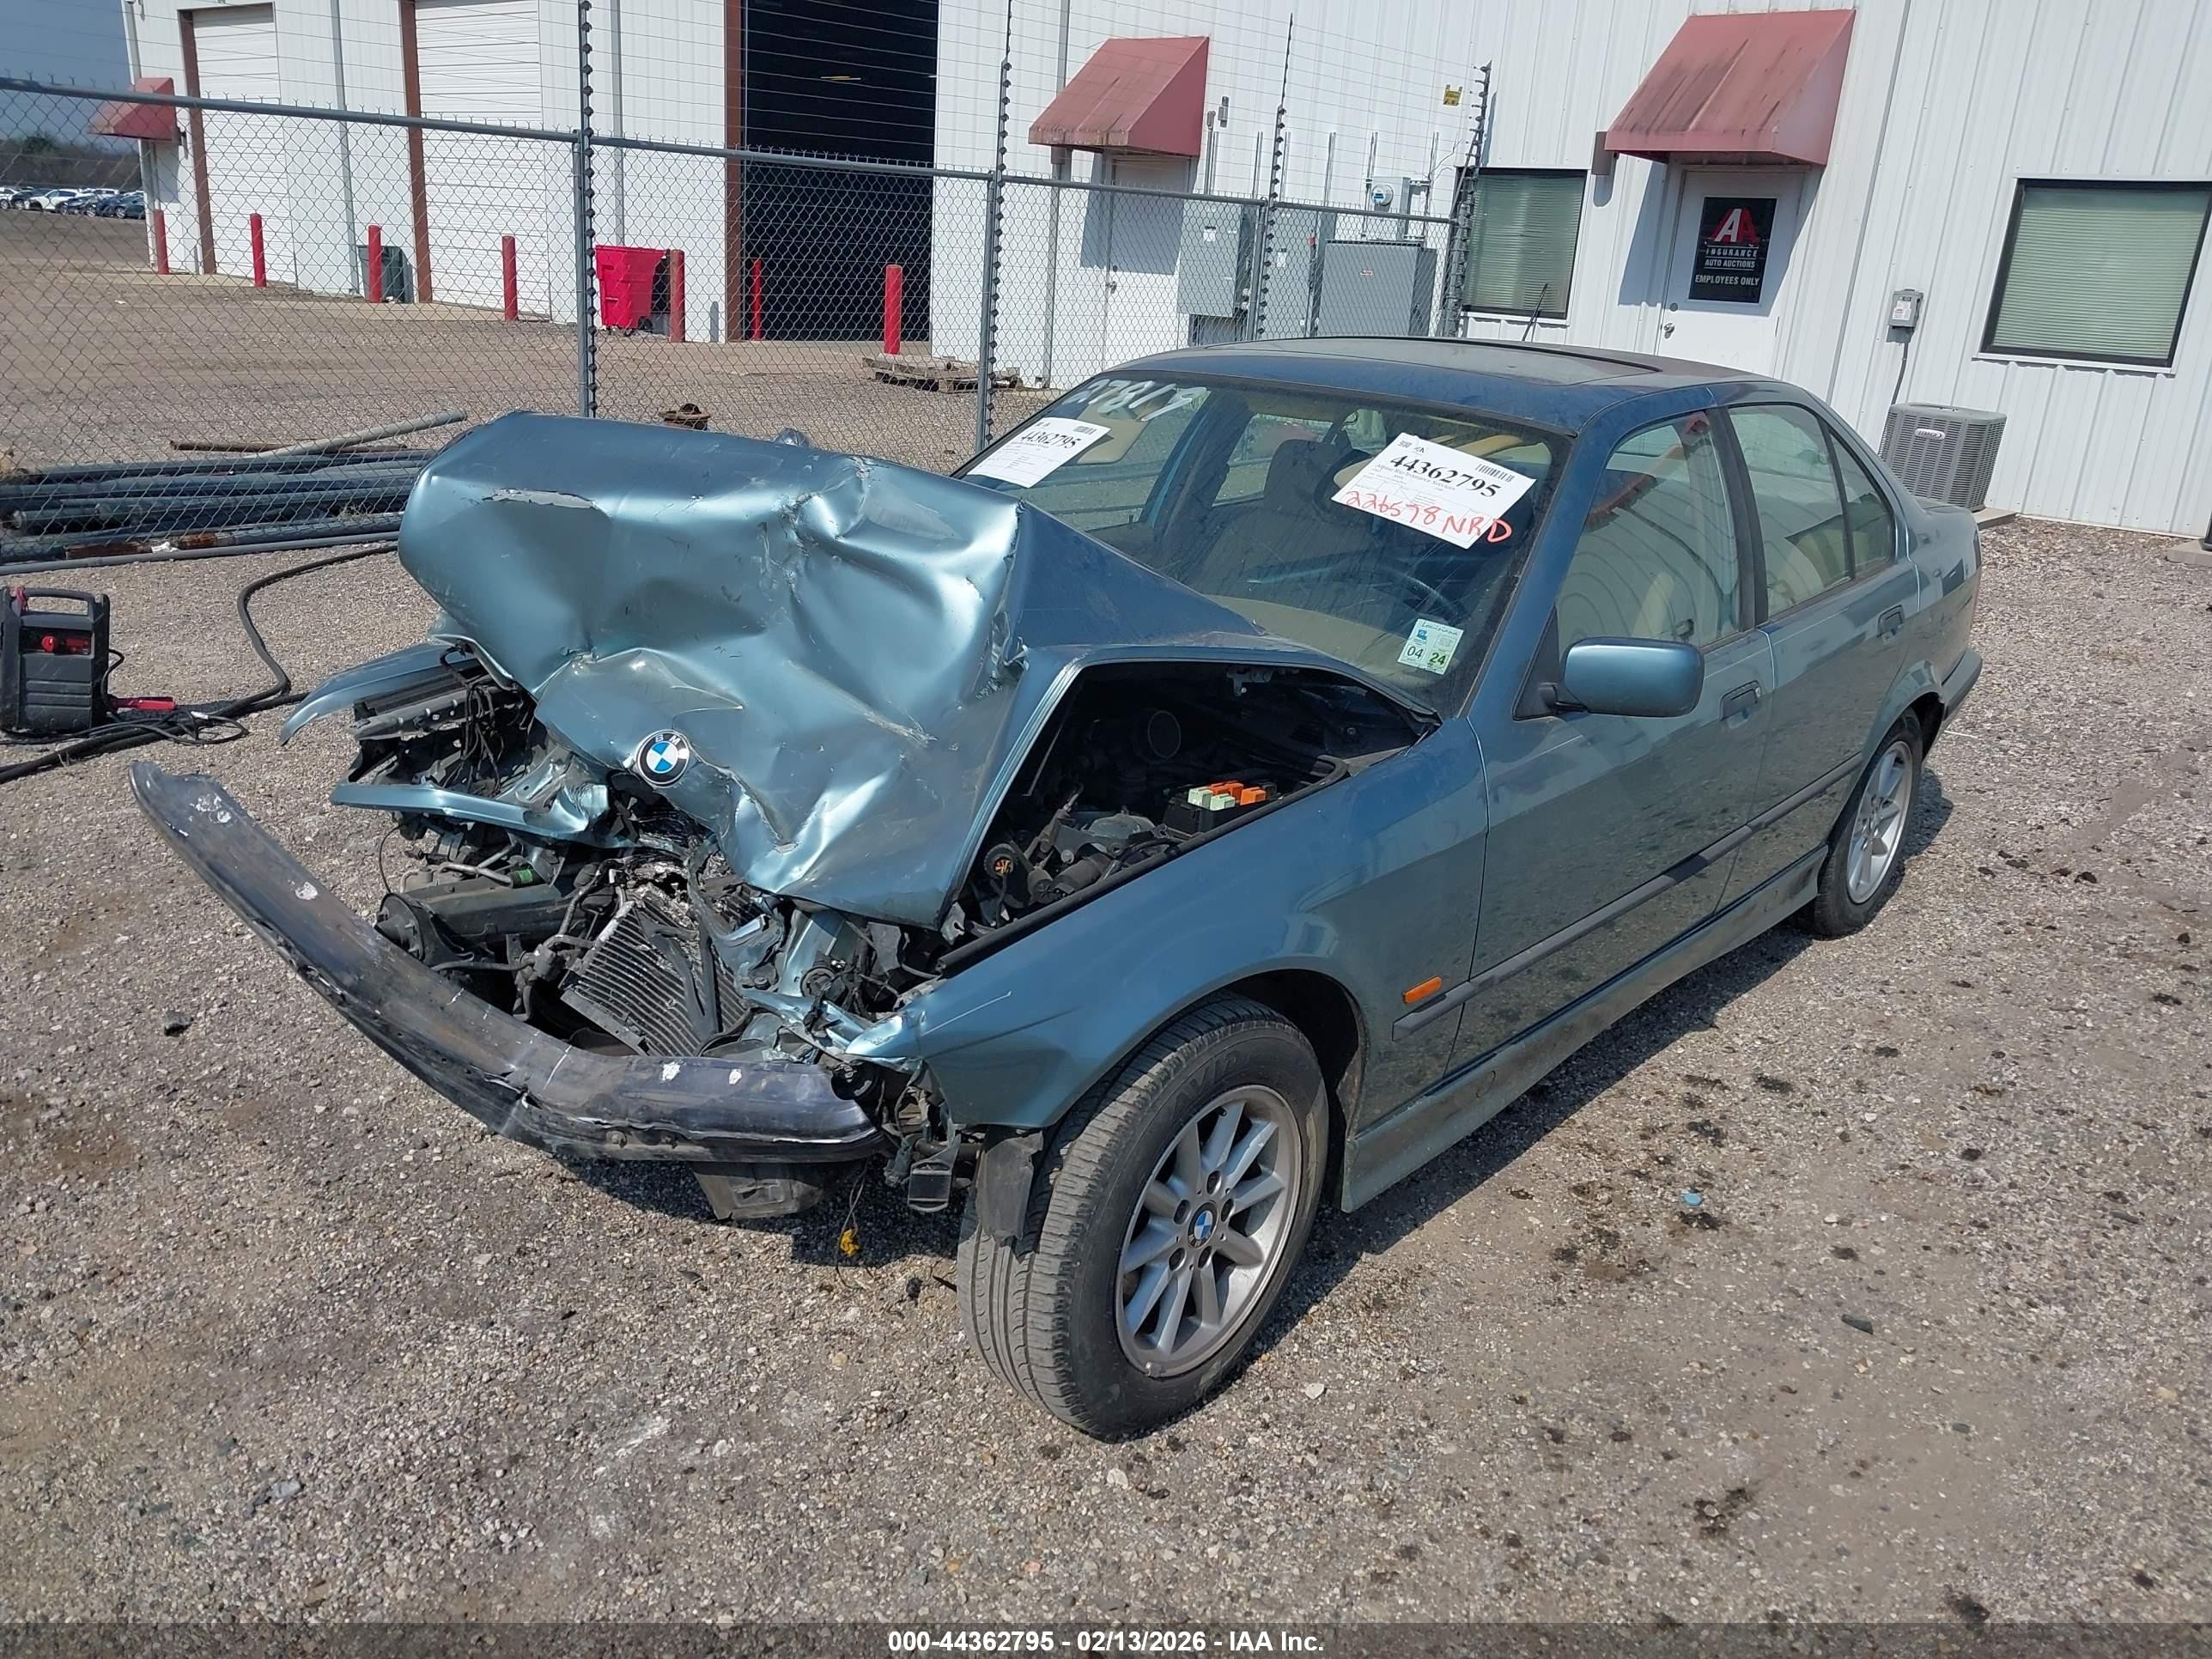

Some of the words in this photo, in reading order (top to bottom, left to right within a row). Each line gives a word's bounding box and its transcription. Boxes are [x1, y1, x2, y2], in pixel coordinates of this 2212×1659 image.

[1706, 248, 1758, 258] INSURANCE
[1705, 258, 1723, 267] AUTO
[1723, 259, 1756, 269] AUCTIONS
[1695, 275, 1740, 286] EMPLOYEES
[1741, 276, 1759, 287] ONLY
[1020, 430, 1082, 449] 44362795
[1389, 455, 1503, 498] 44362795
[1442, 515, 1512, 543] NRD
[1407, 646, 1424, 659] 04
[1428, 652, 1447, 665] 24
